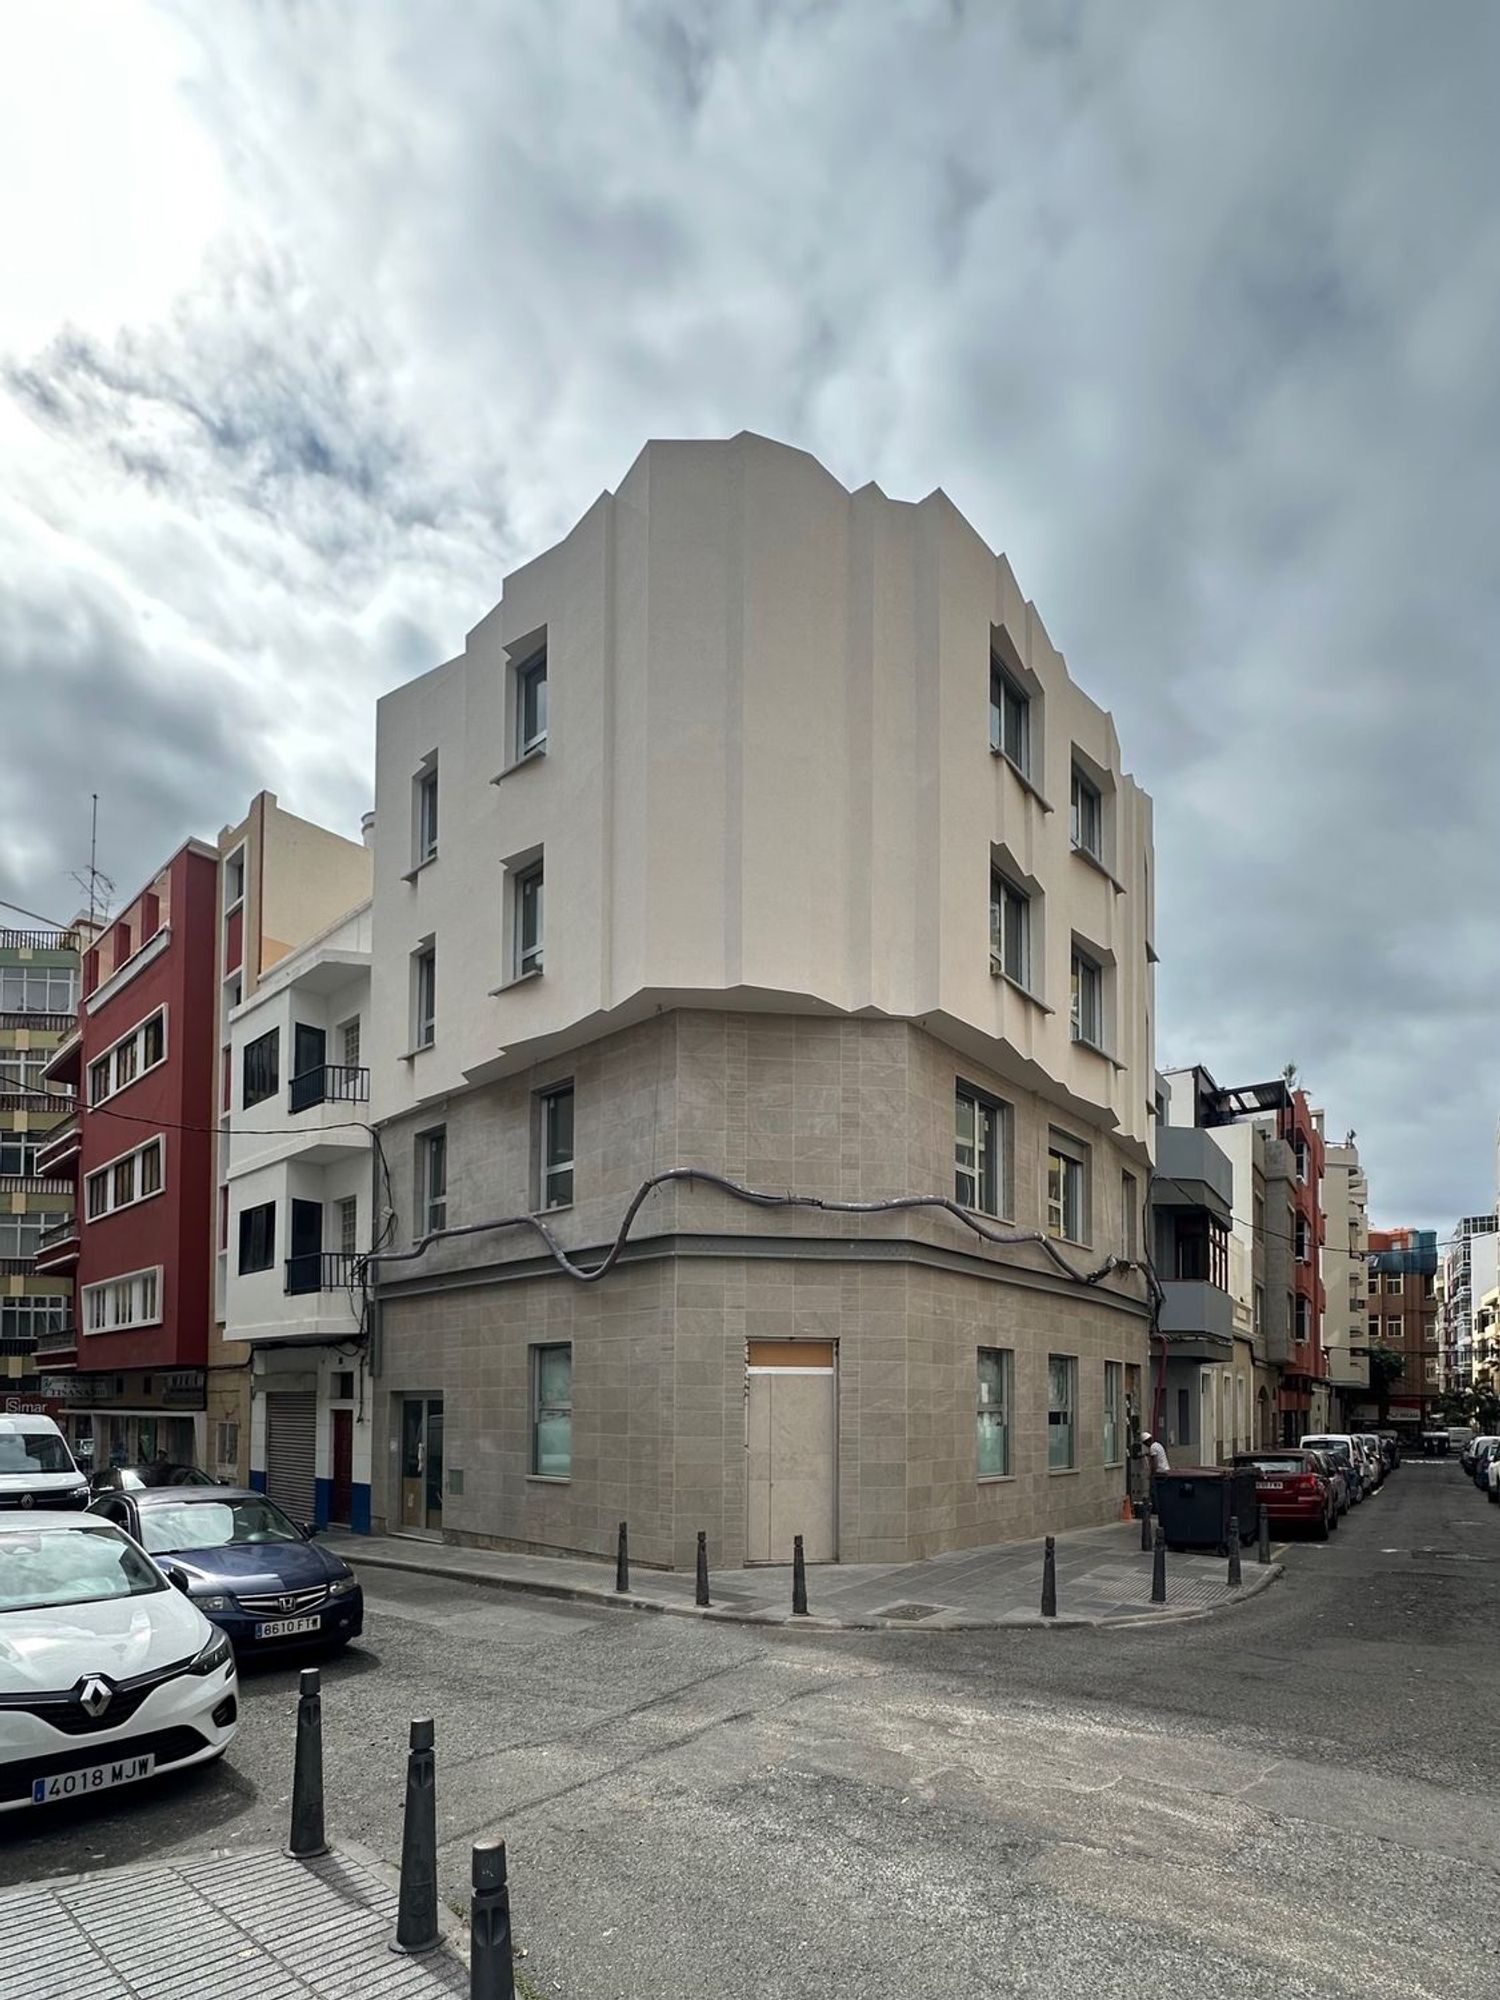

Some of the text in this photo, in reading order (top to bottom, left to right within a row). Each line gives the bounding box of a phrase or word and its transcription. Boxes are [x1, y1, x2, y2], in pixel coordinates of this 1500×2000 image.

[264, 1621, 294, 1636] 8610
[49, 1757, 149, 1796] 4018 MJW
